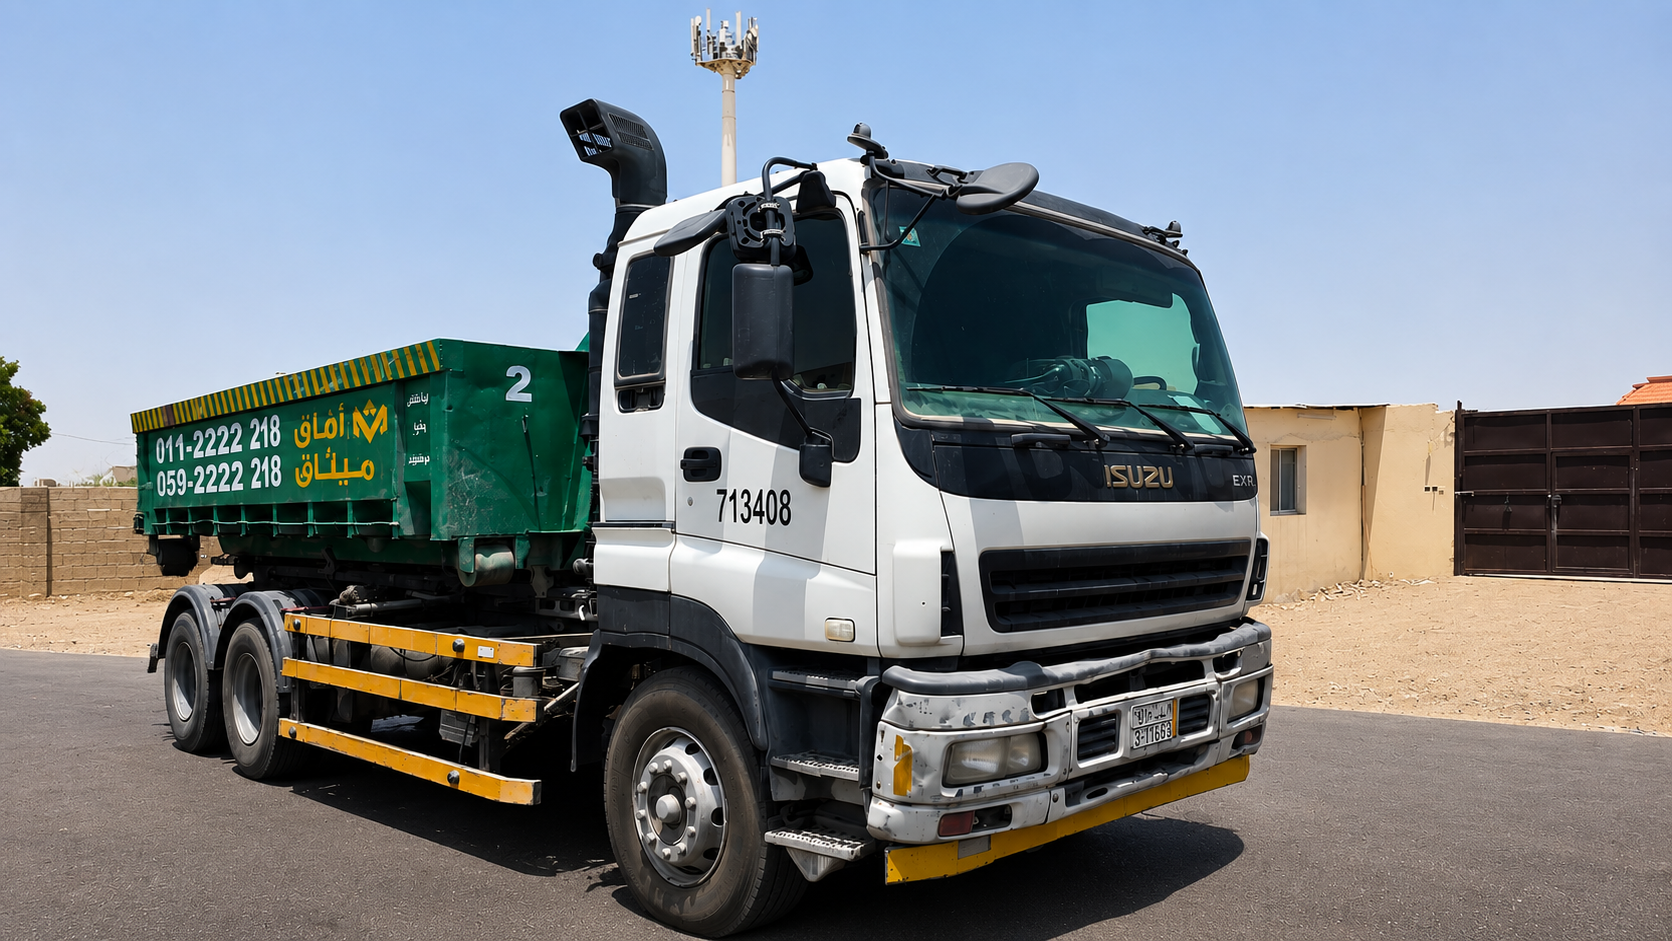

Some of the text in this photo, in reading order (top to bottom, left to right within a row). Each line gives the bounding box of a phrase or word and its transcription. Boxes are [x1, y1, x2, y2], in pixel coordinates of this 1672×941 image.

[505, 365, 532, 403] 2
[156, 414, 281, 464] 011-2222 218
[156, 454, 282, 497] 059-2222 218
[1104, 464, 1174, 489] ISUZU
[716, 488, 792, 526] 713408
